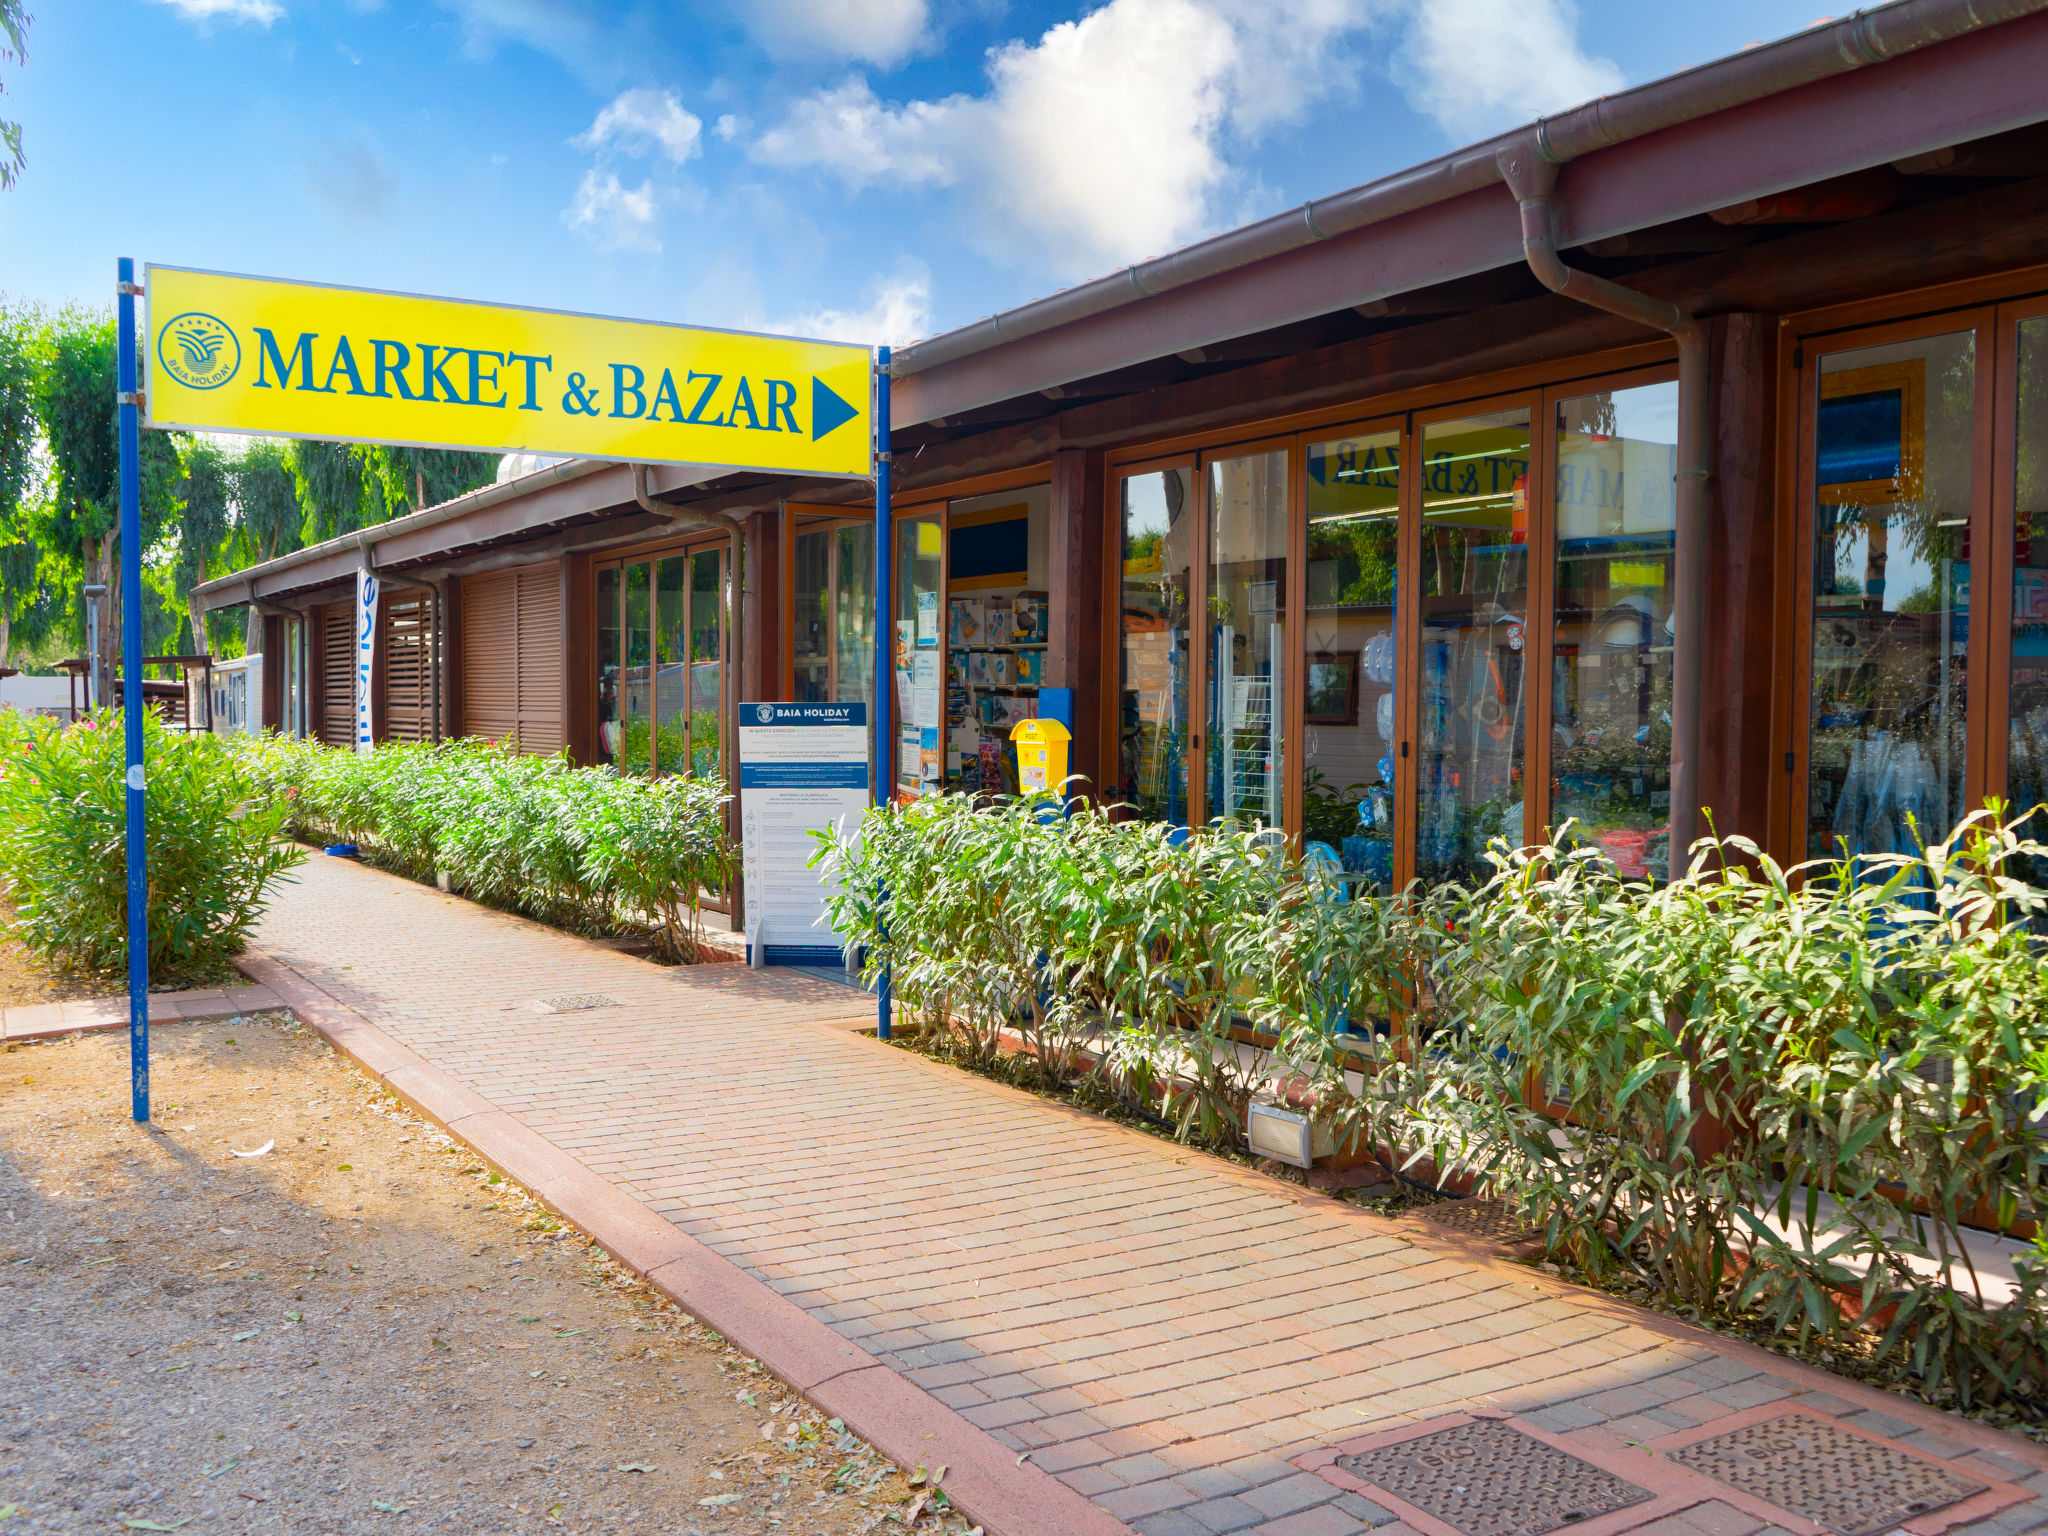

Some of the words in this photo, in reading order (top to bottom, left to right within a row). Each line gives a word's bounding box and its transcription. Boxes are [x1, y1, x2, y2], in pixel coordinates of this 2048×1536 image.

[167, 359, 189, 380] BAIA
[191, 363, 231, 385] HOLIDAY
[252, 327, 552, 412] MARKET
[561, 372, 600, 416] &
[607, 363, 803, 434] BAZAR
[776, 708, 802, 717] BAIA
[804, 708, 850, 717] HOLIDAY
